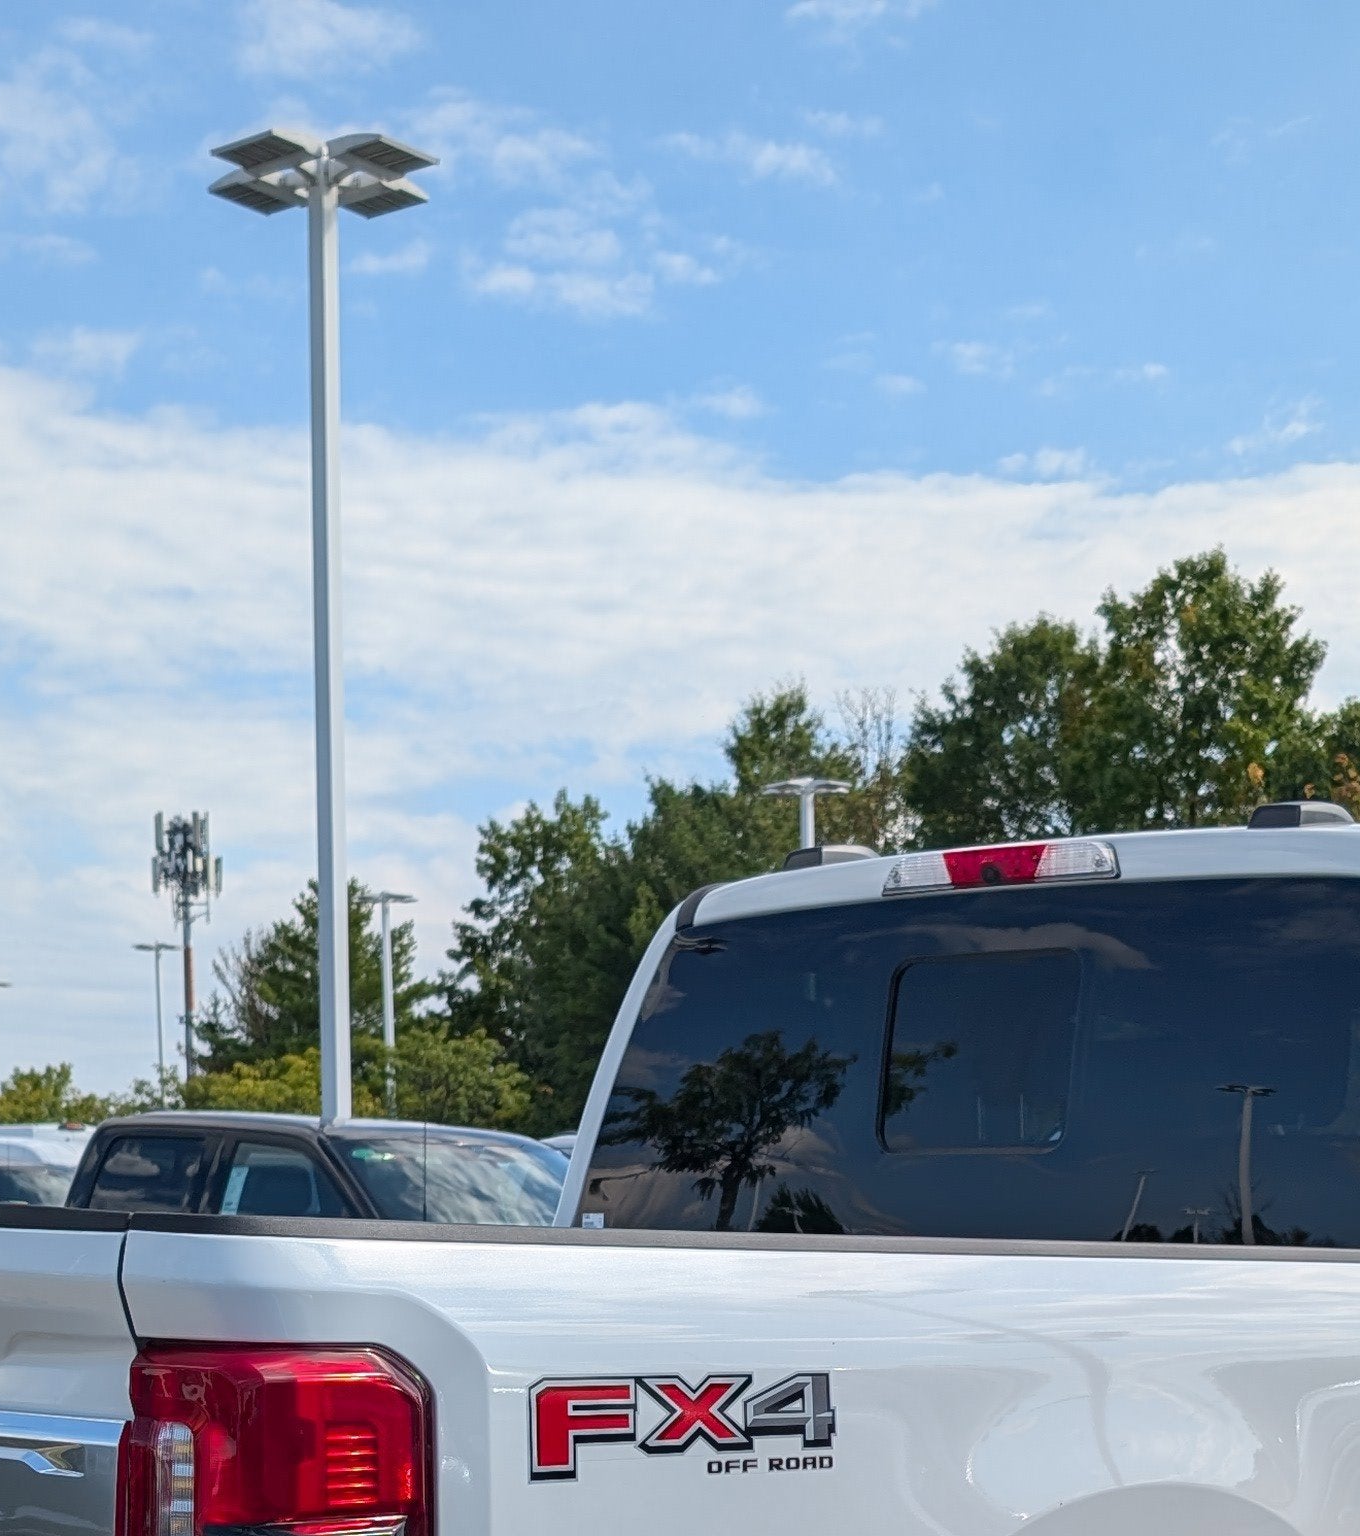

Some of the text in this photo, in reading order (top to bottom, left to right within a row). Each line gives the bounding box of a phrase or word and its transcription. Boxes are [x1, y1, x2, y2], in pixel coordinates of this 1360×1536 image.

[528, 1372, 837, 1484] FX4
[707, 1455, 833, 1475] OFF ROAD
